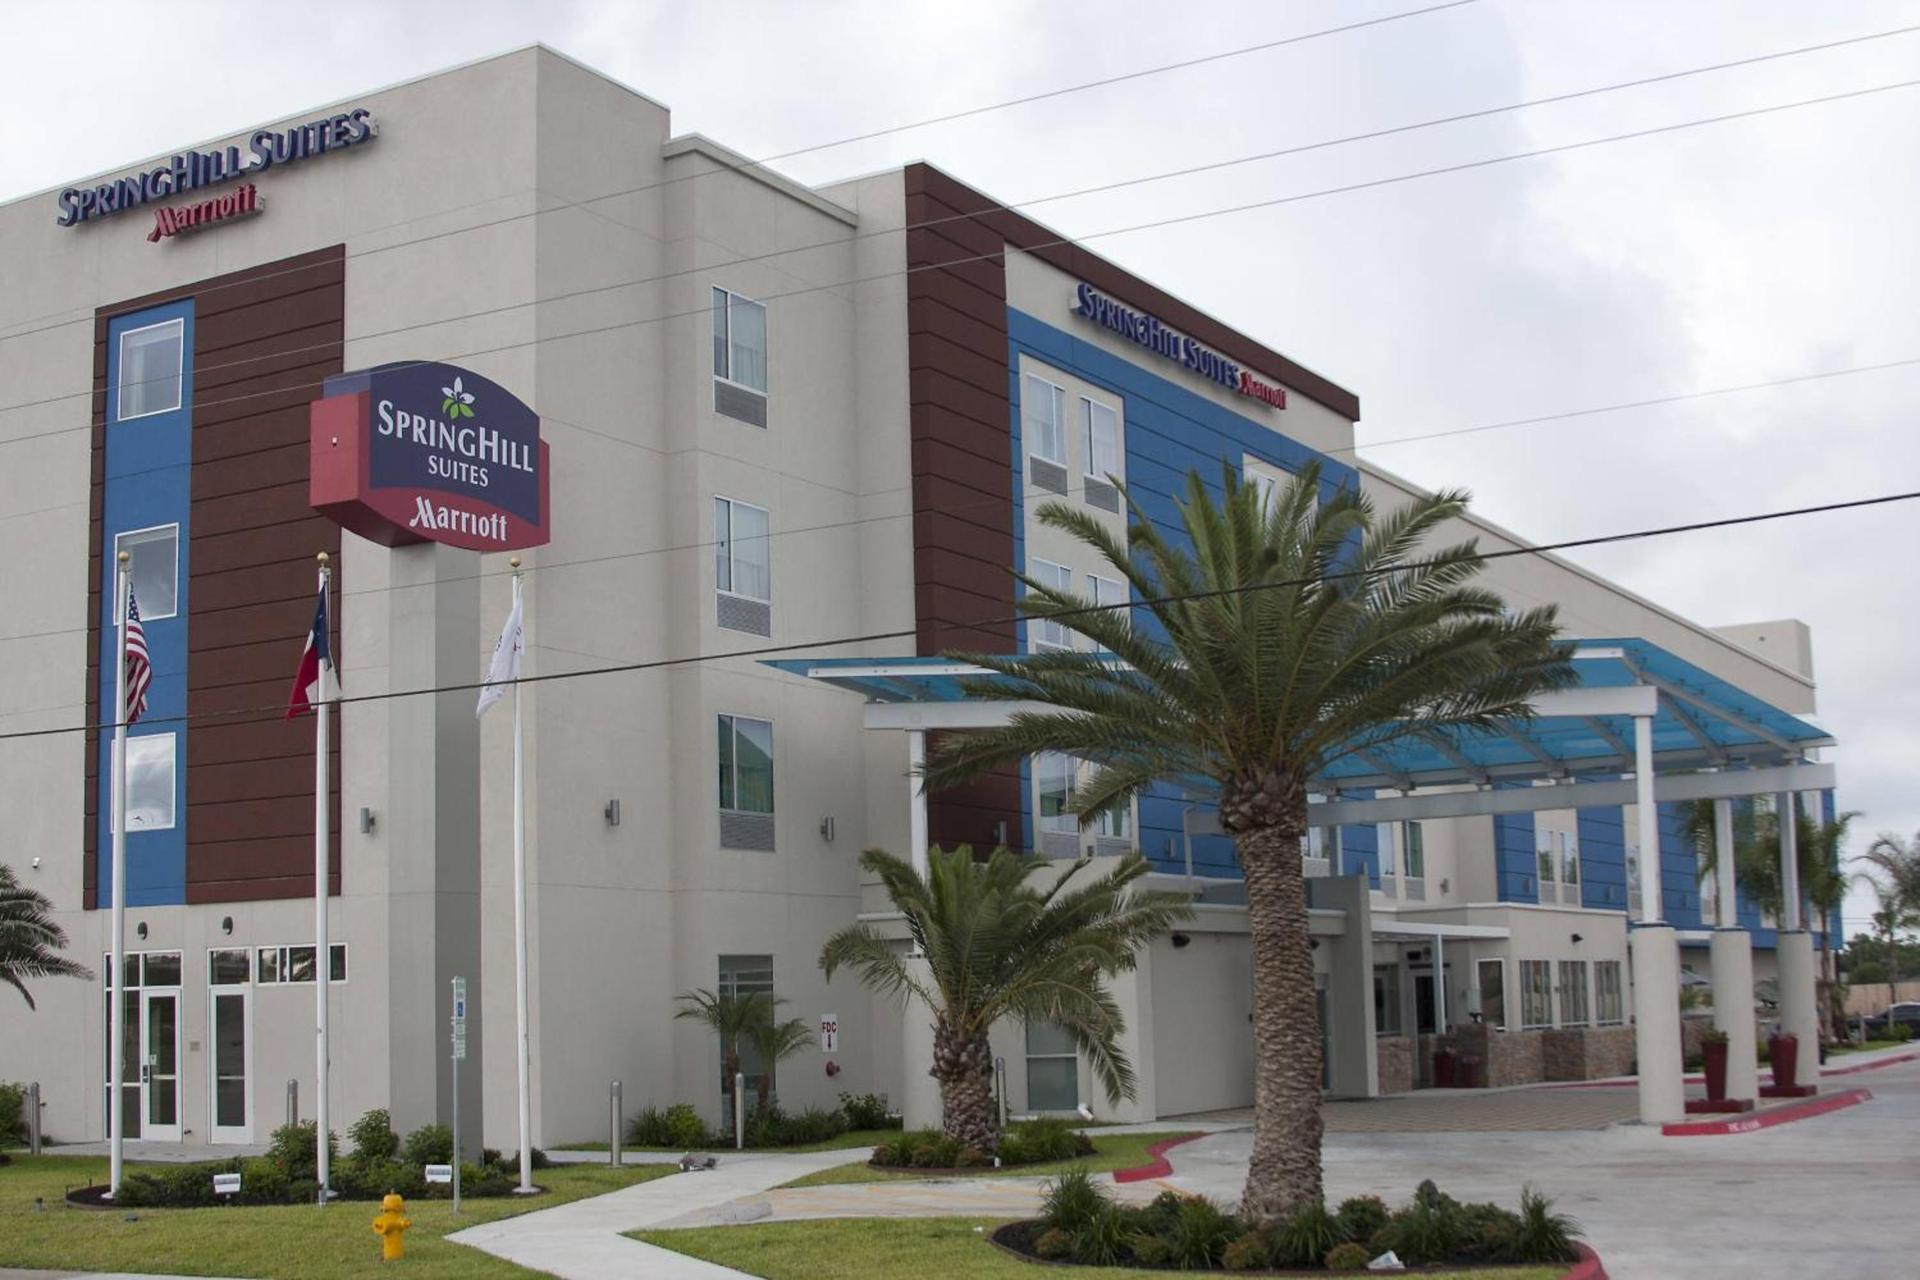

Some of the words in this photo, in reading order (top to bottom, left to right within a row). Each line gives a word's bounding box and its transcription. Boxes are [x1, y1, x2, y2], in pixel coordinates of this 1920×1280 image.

[57, 145, 240, 227] SPRINGHILL
[248, 108, 372, 172] SUITES
[147, 184, 257, 242] Marriott
[1077, 282, 1183, 359] SPRINGHILL
[1183, 337, 1239, 389] SUITES
[378, 400, 533, 472] SPRINGHILL
[428, 455, 489, 487] SUITES
[409, 496, 507, 541] Marriott
[822, 1021, 837, 1034] FDC
